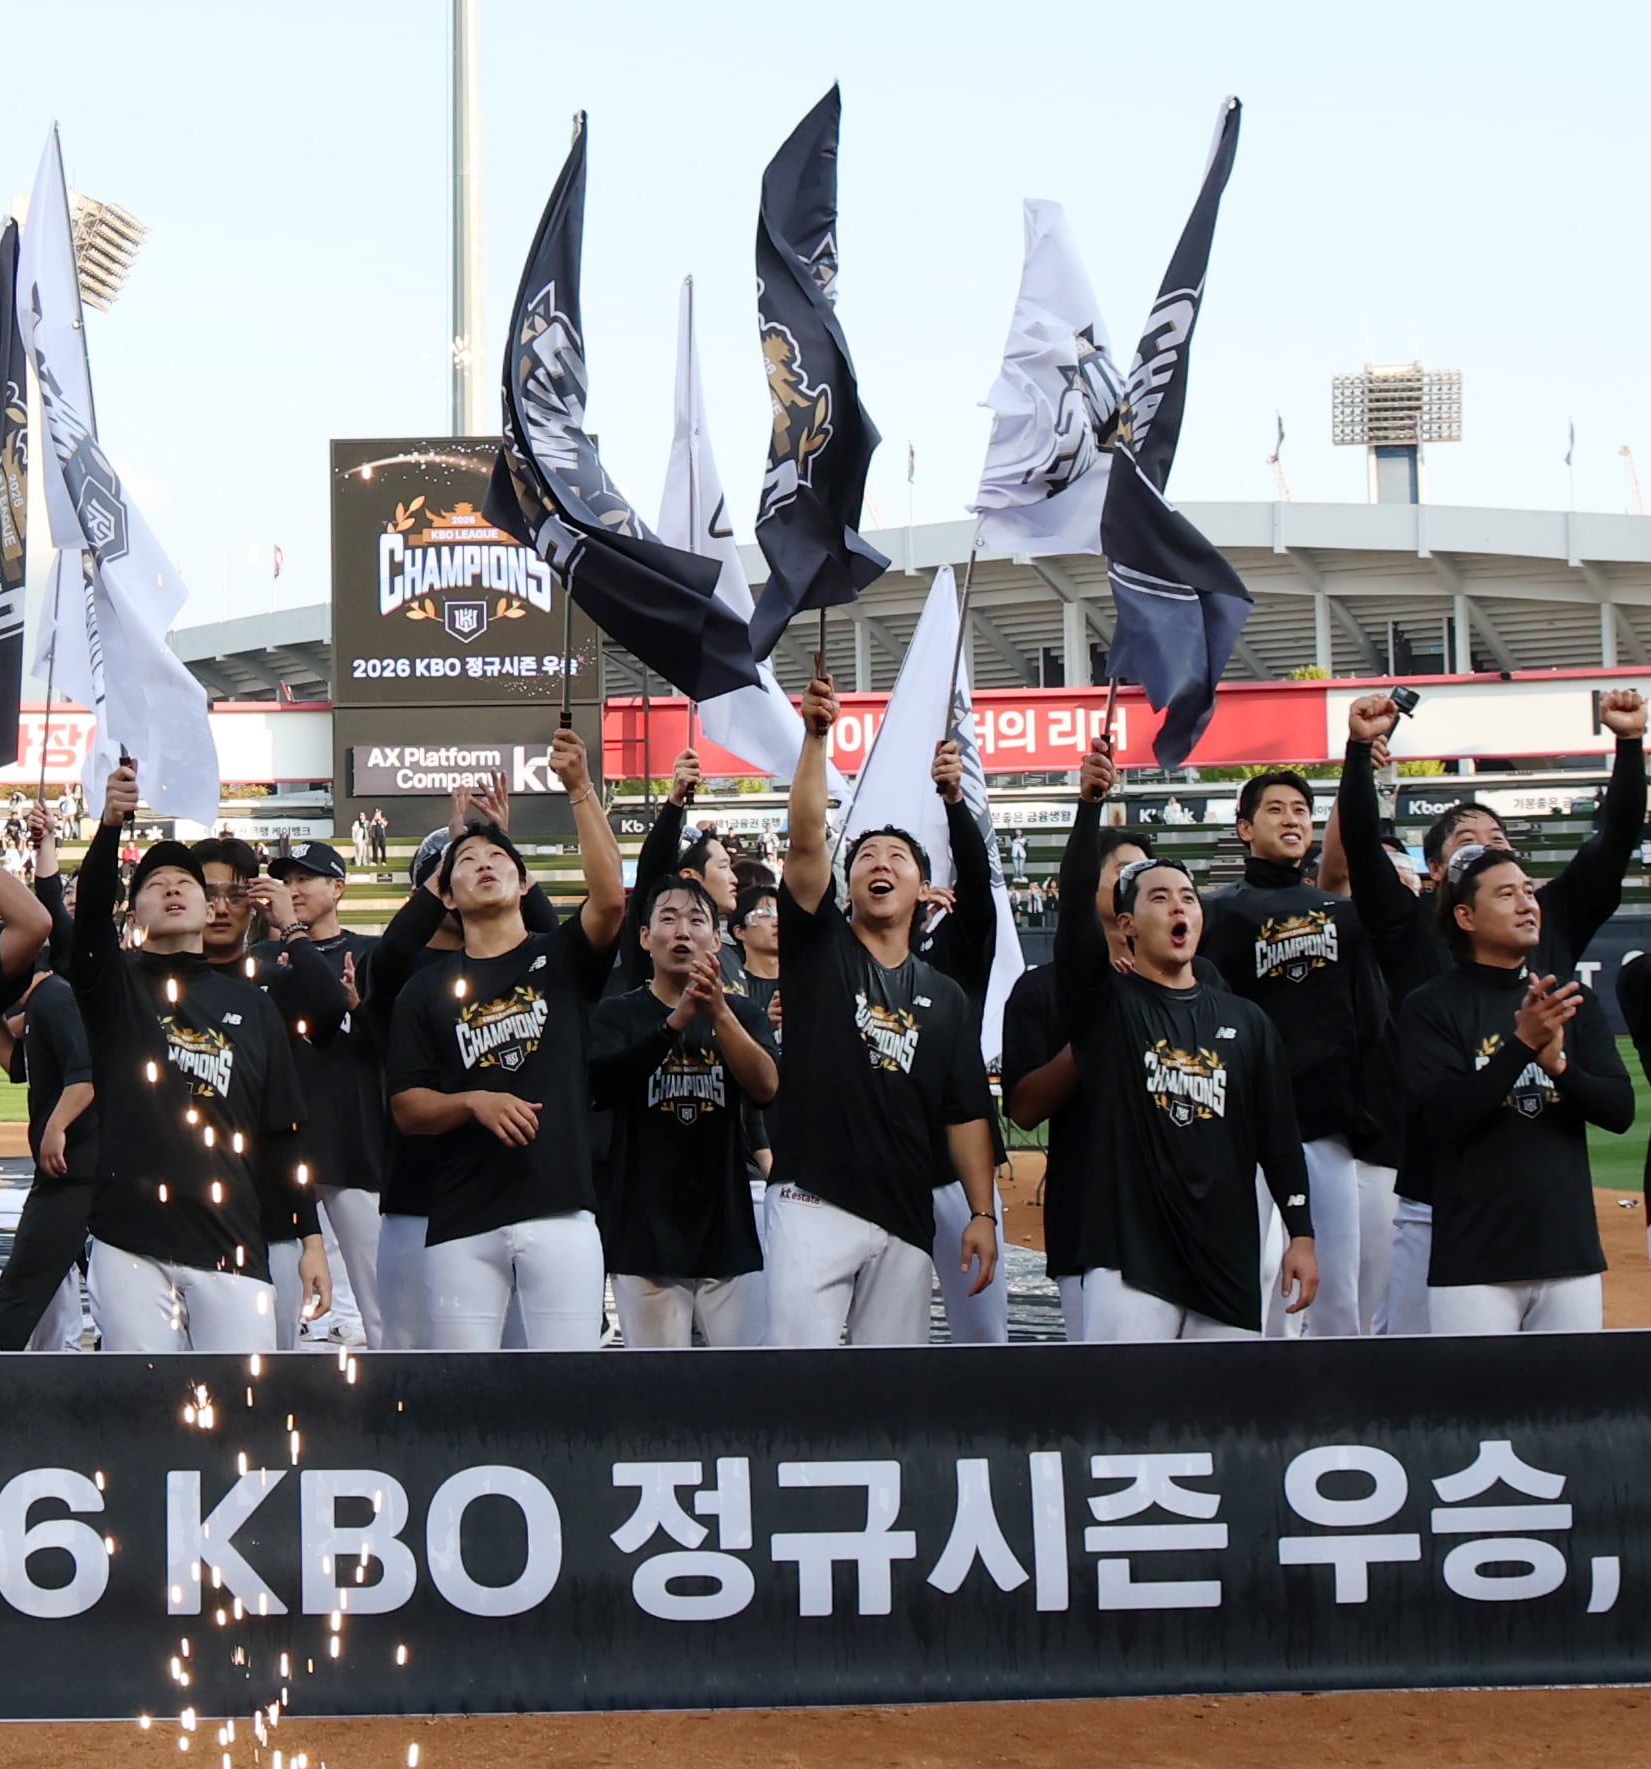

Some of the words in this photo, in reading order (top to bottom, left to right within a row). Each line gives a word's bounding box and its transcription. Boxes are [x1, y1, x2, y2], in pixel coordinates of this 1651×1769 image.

[430, 528, 455, 541] KBO
[457, 528, 499, 541] LEAGUE
[451, 515, 476, 525] 2026
[378, 532, 552, 616] CHAMPIONS
[352, 658, 411, 679] 2026
[415, 657, 462, 679] KBO
[465, 656, 538, 678] 정규시즌
[367, 748, 401, 768] AX
[404, 747, 500, 767] Platform
[1254, 922, 1338, 979] CHAMPIONS
[648, 1065, 726, 1108] CHAMPIONS
[166, 1464, 563, 1617] KBO
[609, 1451, 1229, 1621] 정규시즌
[1278, 1440, 1621, 1613] 우승,
